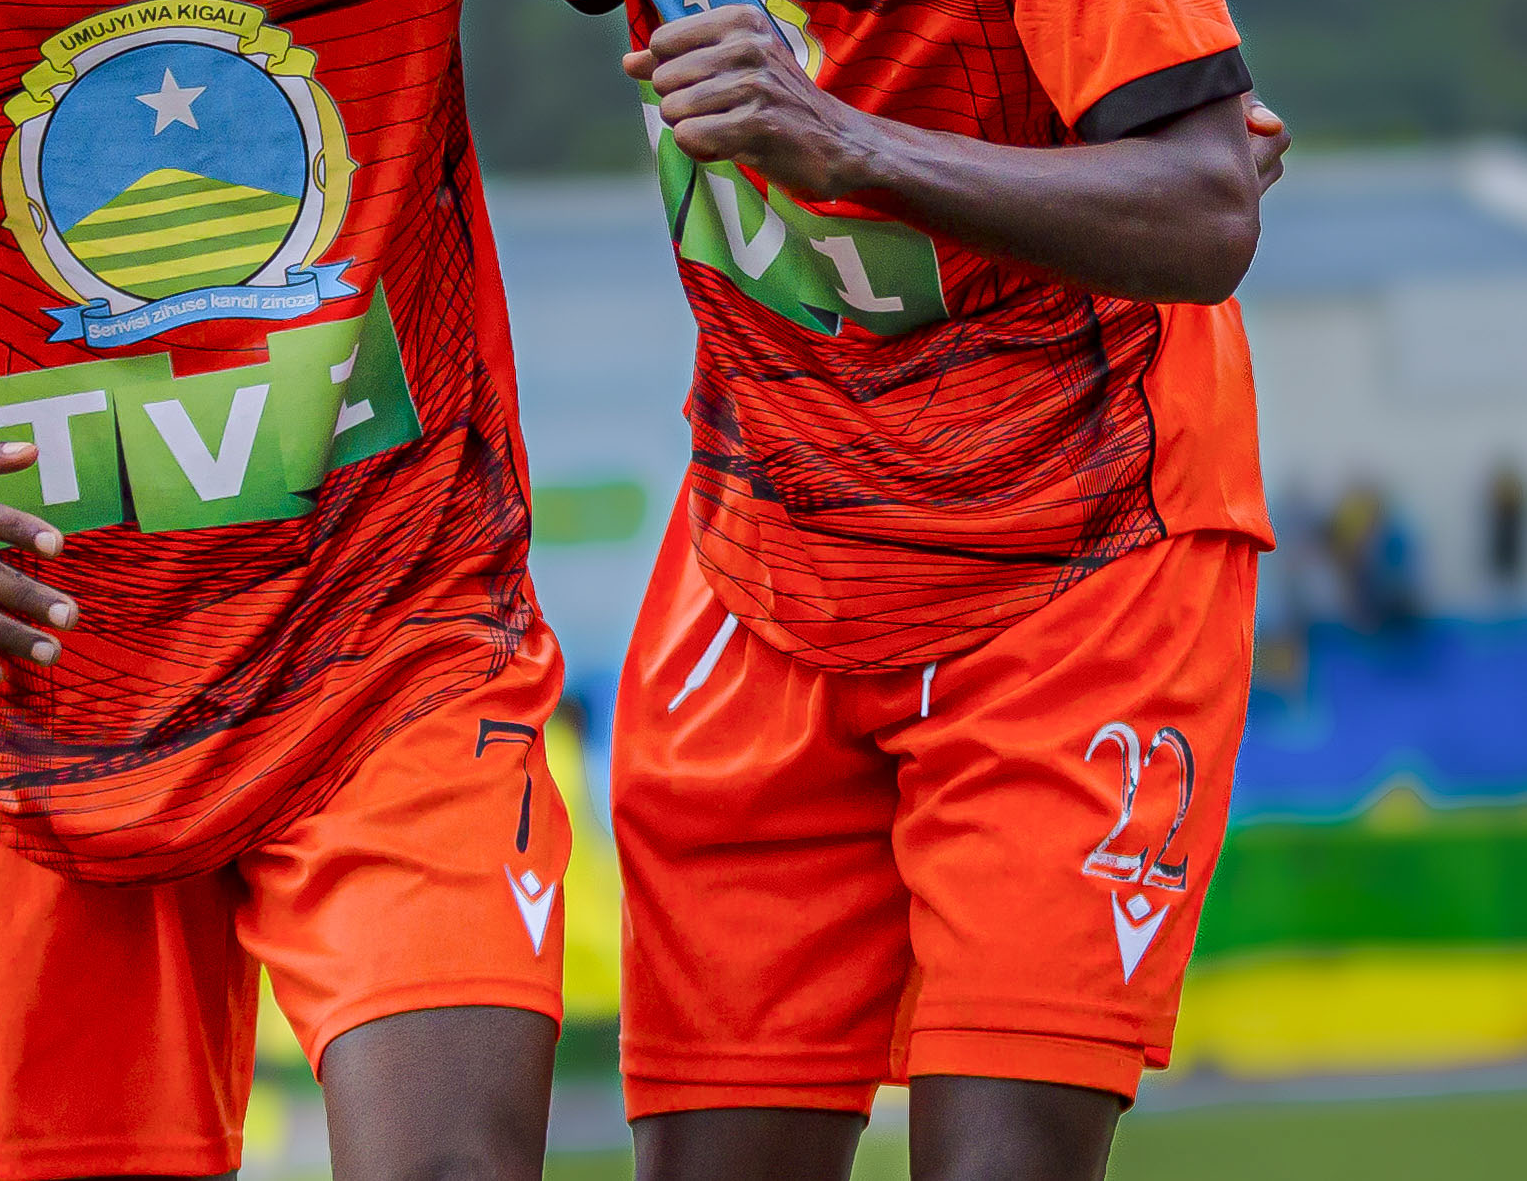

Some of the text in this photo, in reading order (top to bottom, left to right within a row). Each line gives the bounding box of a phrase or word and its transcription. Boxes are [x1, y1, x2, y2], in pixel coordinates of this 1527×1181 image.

[60, 4, 247, 51] UMUJYI WA KIGALI
[88, 311, 149, 339] Serivisi
[151, 297, 207, 321] zihuse
[209, 292, 258, 310] kandi
[475, 718, 539, 854] 7
[1082, 721, 1191, 892] 22
